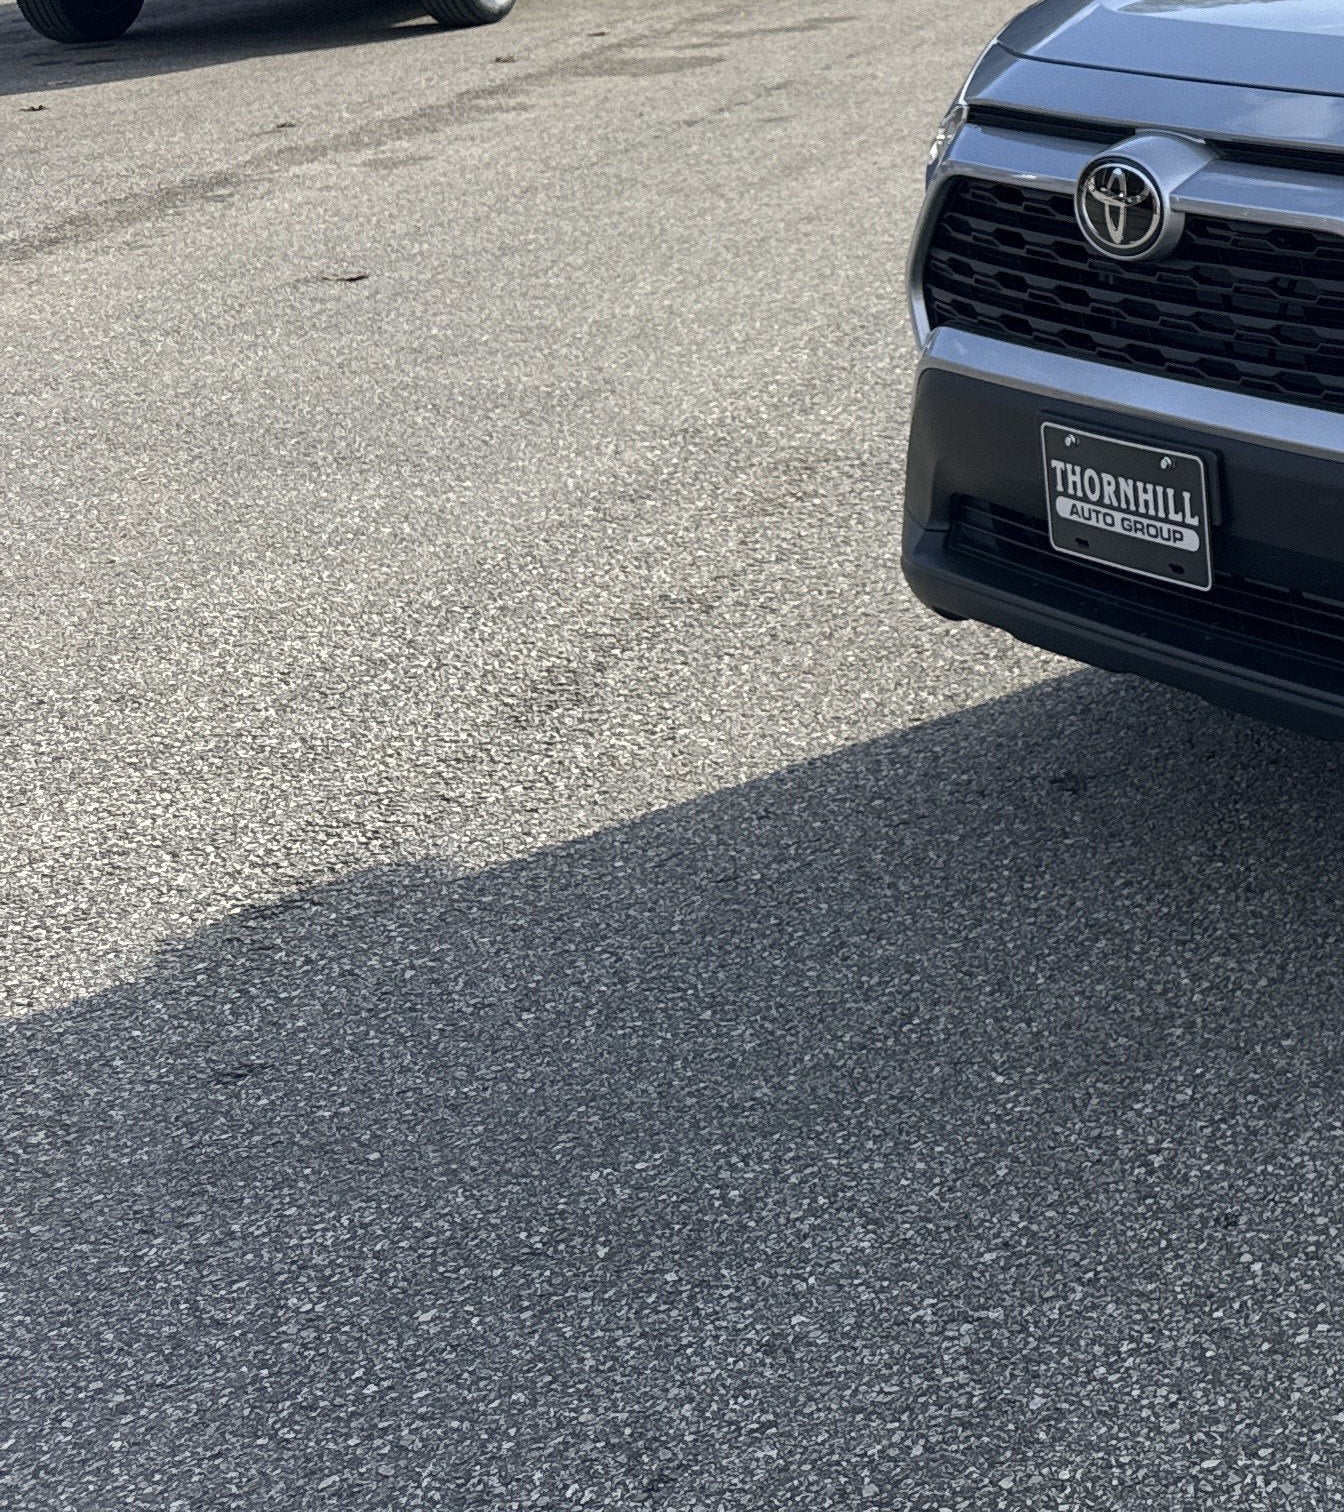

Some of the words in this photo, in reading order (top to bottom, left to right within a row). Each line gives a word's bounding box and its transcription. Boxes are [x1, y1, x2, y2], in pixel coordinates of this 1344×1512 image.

[1051, 460, 1199, 526] THORNHILL
[1070, 503, 1115, 527] AUTO
[1121, 517, 1184, 543] GROUP
